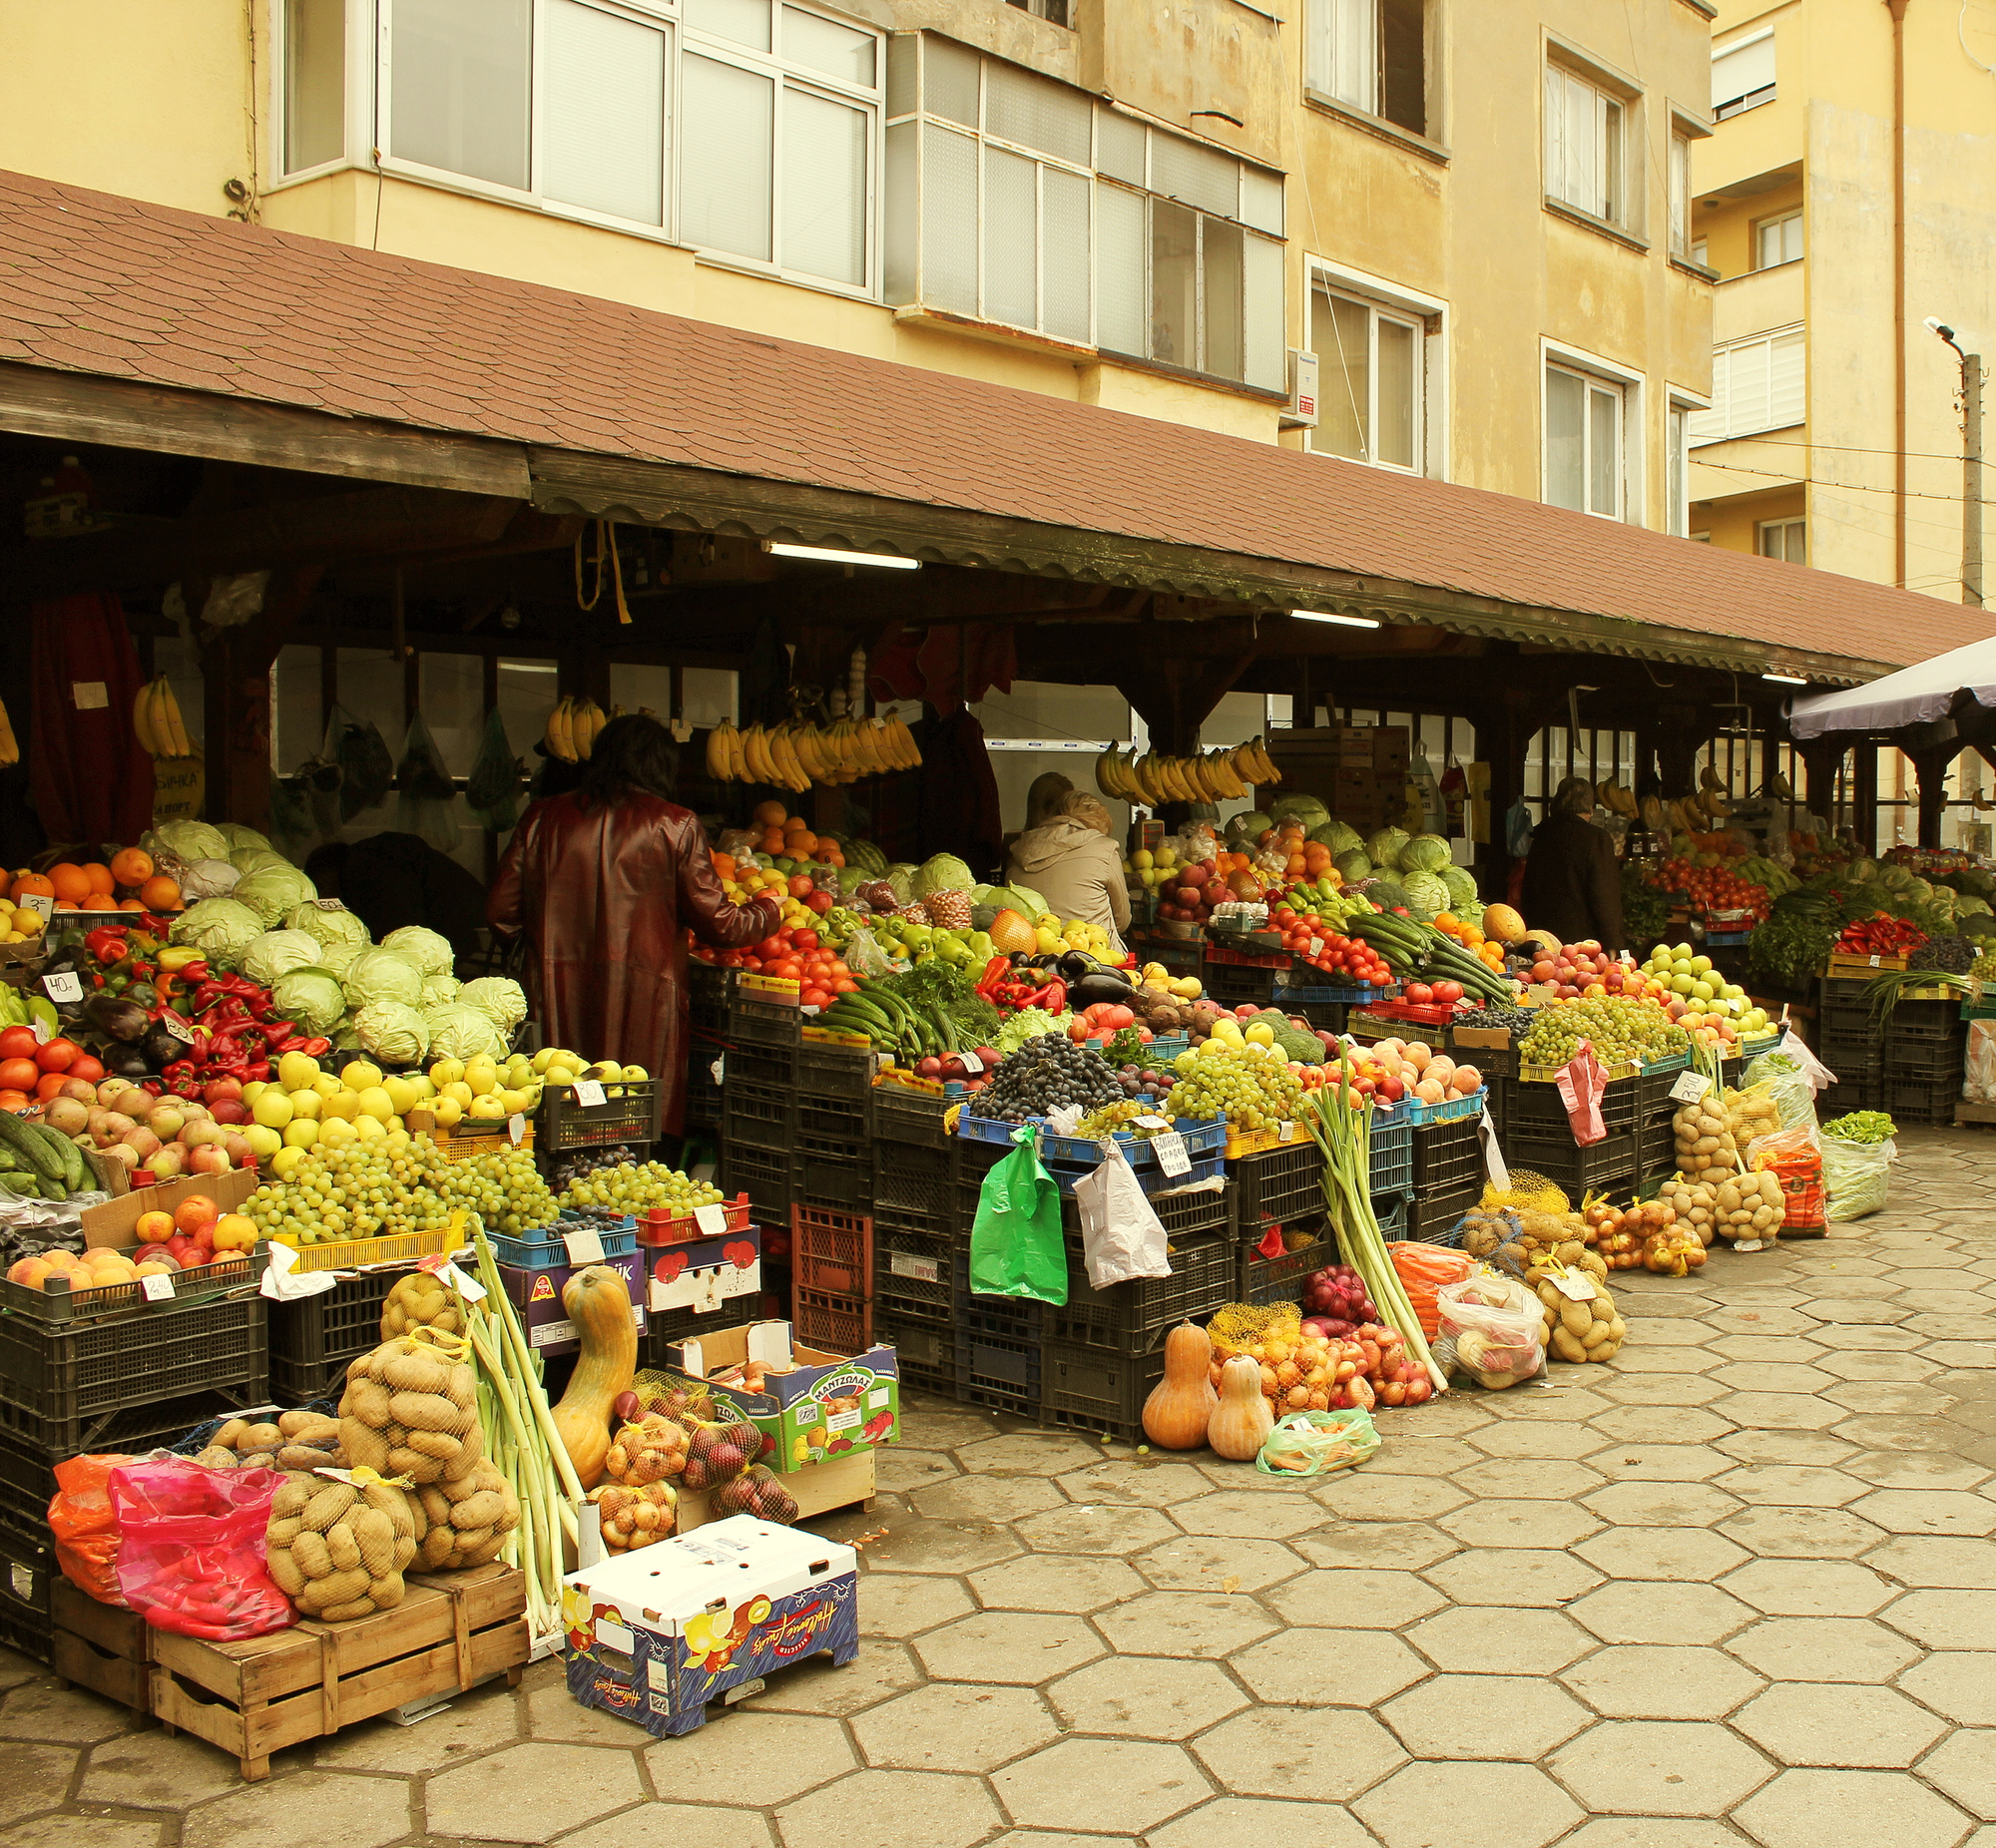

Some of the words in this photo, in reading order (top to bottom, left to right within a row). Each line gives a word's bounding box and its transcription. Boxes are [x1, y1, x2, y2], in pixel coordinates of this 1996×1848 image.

[814, 1375, 871, 1401] ΜΑΝΤΖΩΛΑΣ
[750, 1613, 795, 1656] fruits
[779, 1637, 808, 1654] SELECTED
